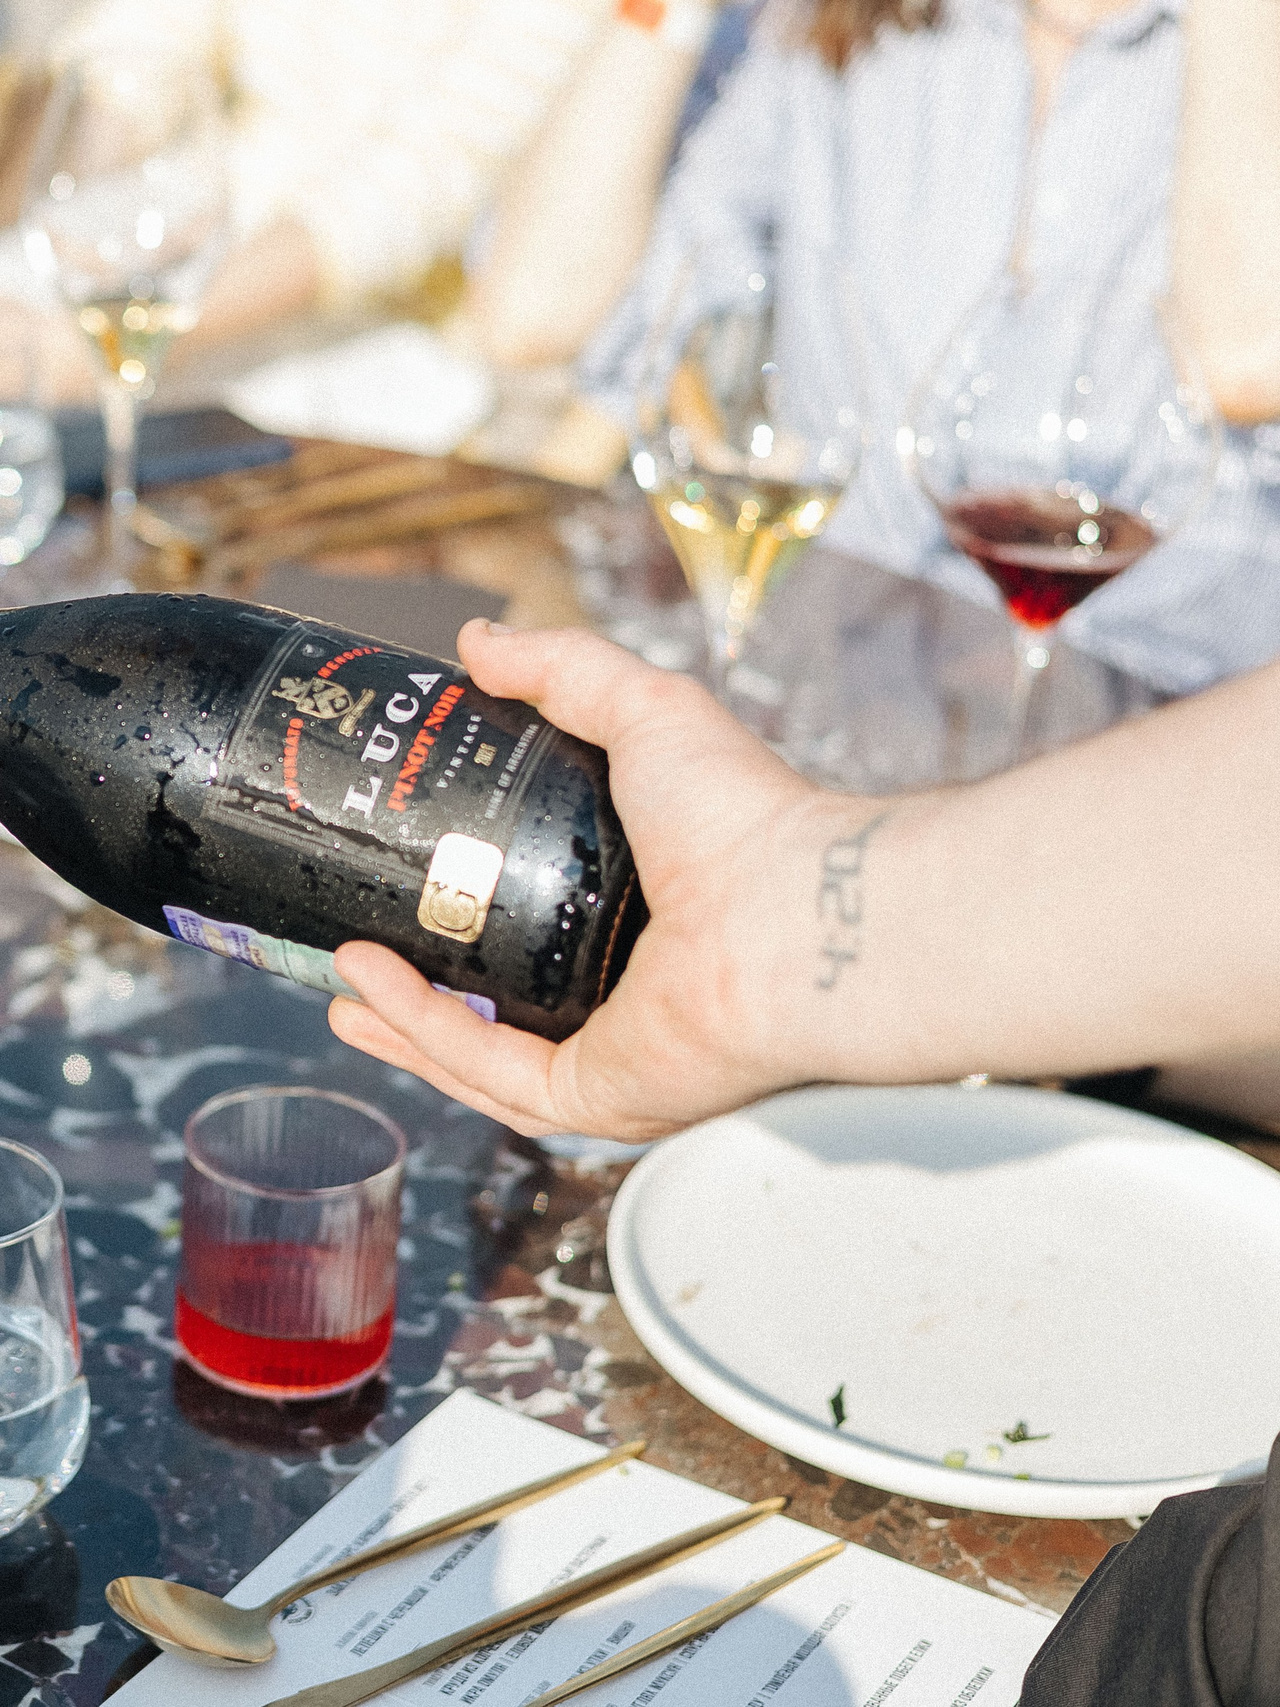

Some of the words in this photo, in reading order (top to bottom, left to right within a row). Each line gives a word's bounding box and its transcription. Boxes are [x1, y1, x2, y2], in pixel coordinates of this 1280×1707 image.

[341, 673, 443, 819] LUCA
[386, 724, 437, 813] PINOT
[424, 684, 466, 732] NOIR
[436, 713, 483, 789] VINTAGE
[485, 781, 507, 819] WINE
[497, 766, 513, 786] OF
[506, 723, 540, 777] ARGENTINA
